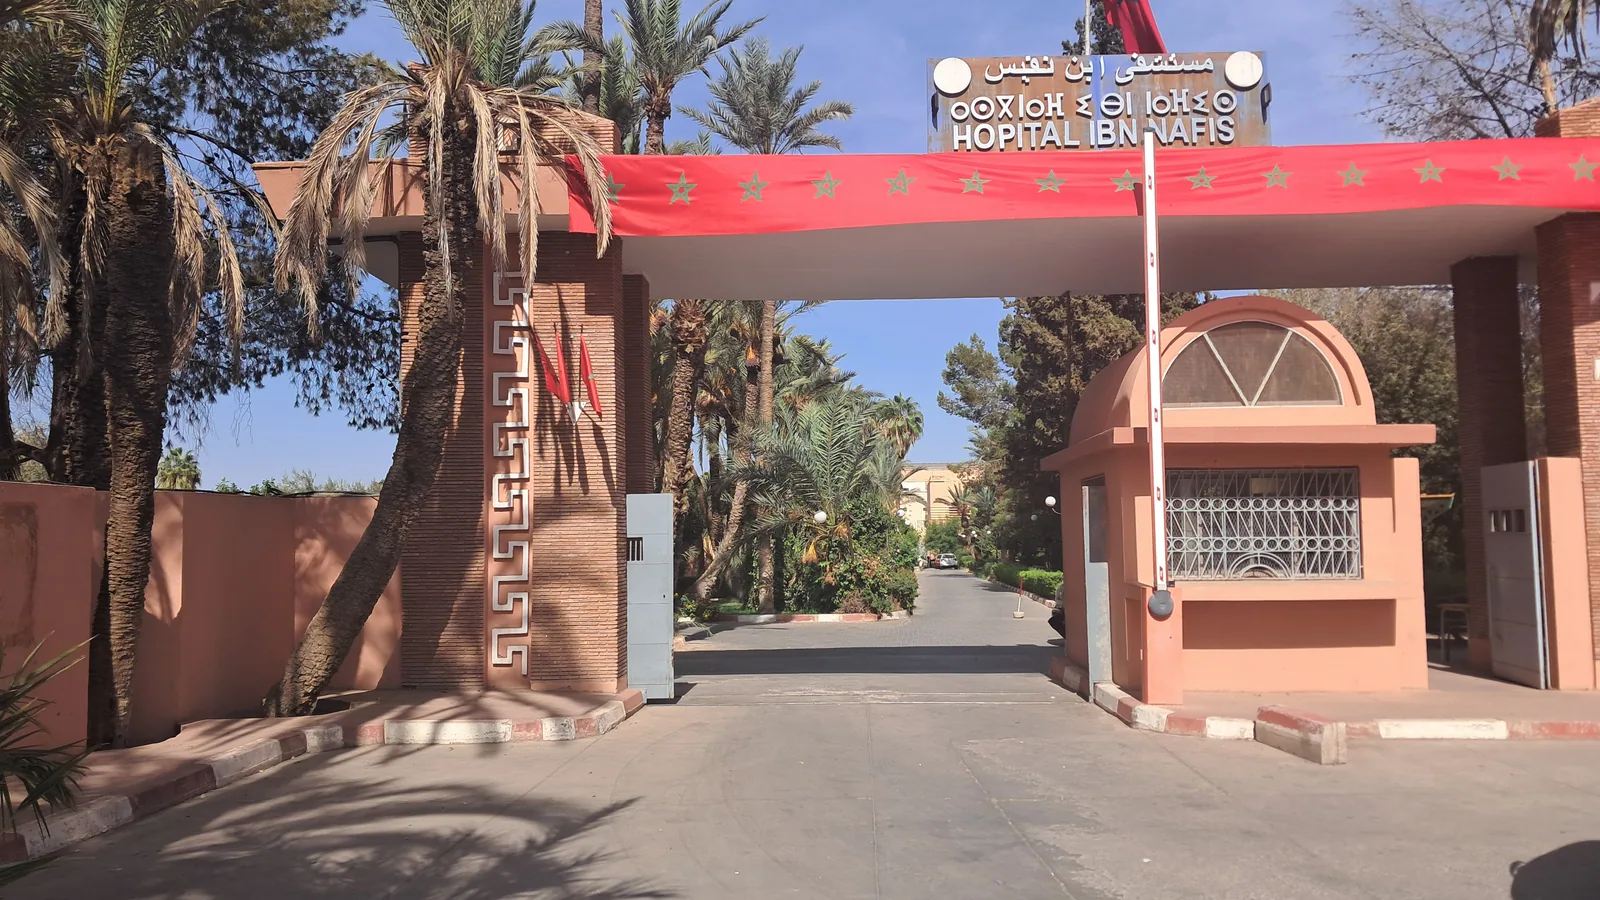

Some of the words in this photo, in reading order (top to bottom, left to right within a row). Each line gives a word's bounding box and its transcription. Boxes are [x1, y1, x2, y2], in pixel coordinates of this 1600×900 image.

[985, 55, 1055, 82] نفيس
[1065, 55, 1105, 82] ابن
[1115, 52, 1214, 84] مستشفى
[953, 121, 1080, 150] HOPITAL
[1090, 119, 1138, 146] IBN
[1148, 116, 1235, 145] NAFIS
